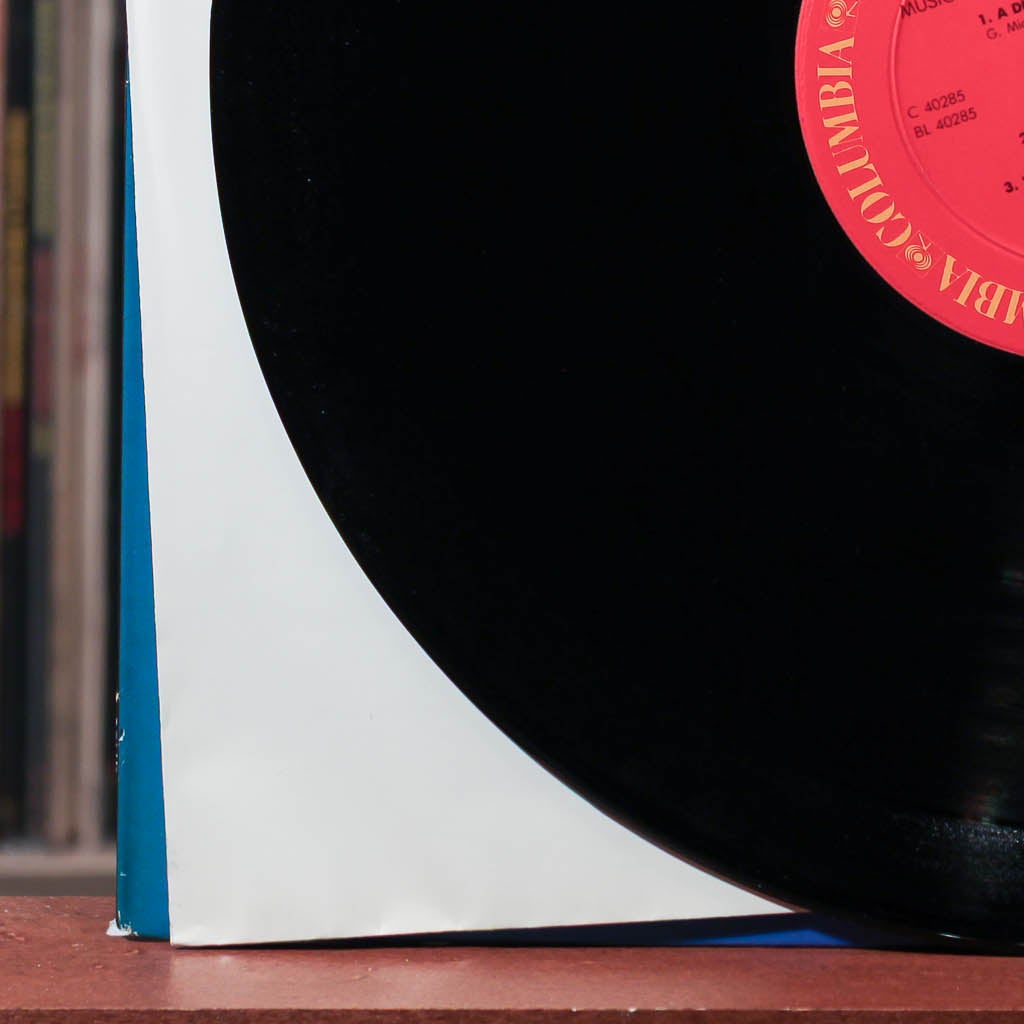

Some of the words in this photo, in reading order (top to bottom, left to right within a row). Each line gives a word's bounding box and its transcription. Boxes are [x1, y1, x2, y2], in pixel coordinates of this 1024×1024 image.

[978, 14, 993, 25] 1.
[997, 7, 1009, 19] A
[986, 27, 1002, 40] G.
[906, 105, 920, 119] C
[924, 89, 966, 113] 40285
[914, 123, 932, 139] BL
[936, 106, 977, 130] 40285
[817, 36, 912, 247] COLUMBIA
[1003, 180, 1019, 193] 3.
